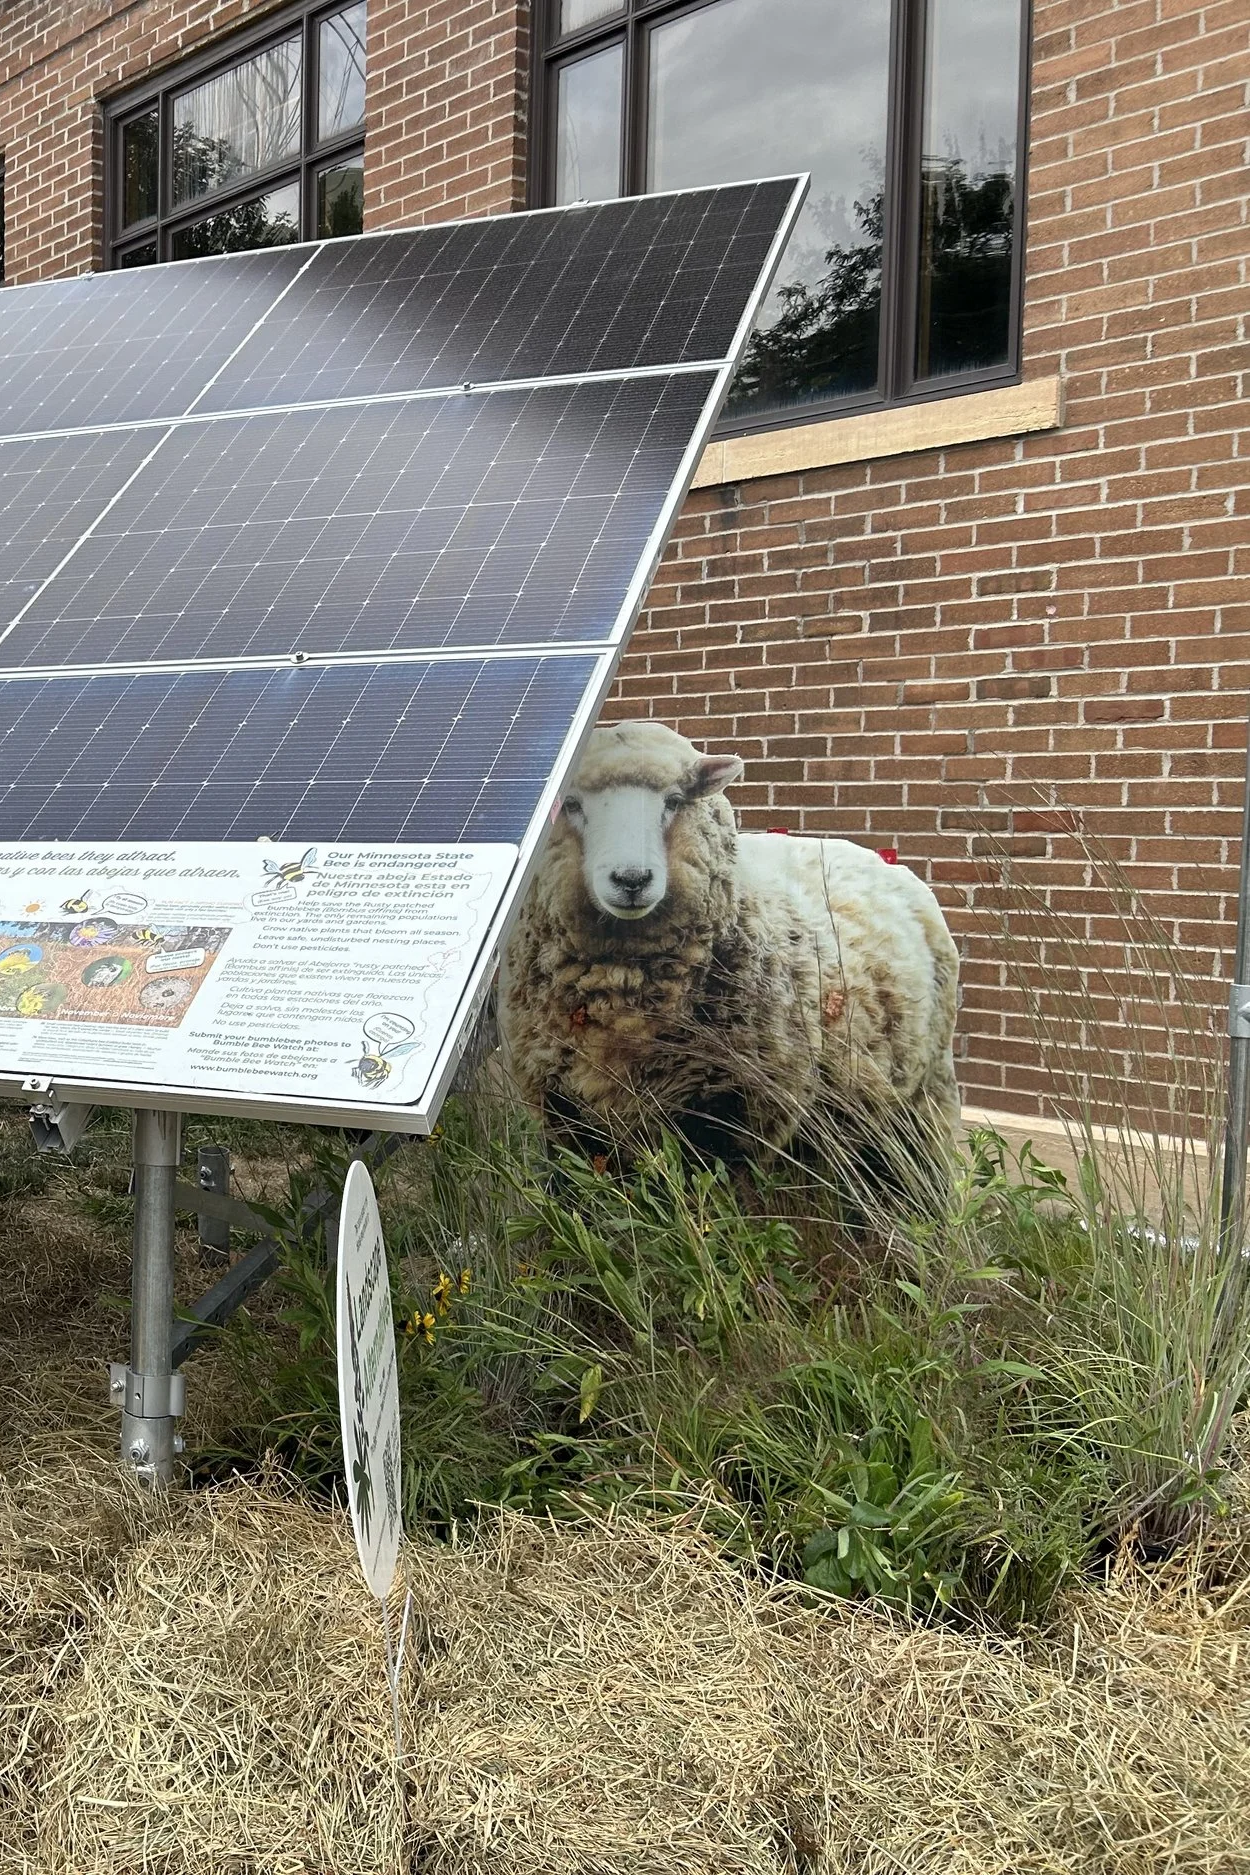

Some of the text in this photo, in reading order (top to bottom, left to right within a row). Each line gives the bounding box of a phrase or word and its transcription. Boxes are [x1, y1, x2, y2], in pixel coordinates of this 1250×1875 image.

[41, 850, 76, 860] bees
[77, 850, 114, 864] they
[116, 850, 177, 861] attract.
[327, 851, 474, 860] Our Minnesota State
[323, 860, 458, 869] Bee is endangered
[8, 867, 25, 878] y
[27, 867, 56, 876] con
[58, 865, 83, 876] las
[86, 866, 140, 880] abejas
[142, 868, 177, 880] que
[178, 866, 240, 878] atraen.
[316, 872, 474, 882] Nuestra abeja Estado
[312, 880, 331, 888] de
[333, 881, 411, 889] Minnesota
[306, 889, 358, 898] peligro
[384, 890, 454, 898] extinción
[366, 993, 414, 1001] florezcan
[60, 1008, 110, 1017] November
[217, 1009, 253, 1017] lugares
[277, 1013, 332, 1021] contengan
[301, 1007, 348, 1015] molestar
[188, 1031, 223, 1039] Submit
[247, 1035, 303, 1044] bumblebee
[303, 1039, 338, 1047] photos
[213, 1039, 250, 1048] Bumble
[273, 1043, 304, 1051] Watch
[187, 1047, 220, 1055] Mande
[239, 1050, 264, 1058] fotos
[280, 1054, 329, 1063] abejorros
[190, 1064, 319, 1080] www.bumblebeewatch.org
[353, 1234, 382, 1343] Landscape
